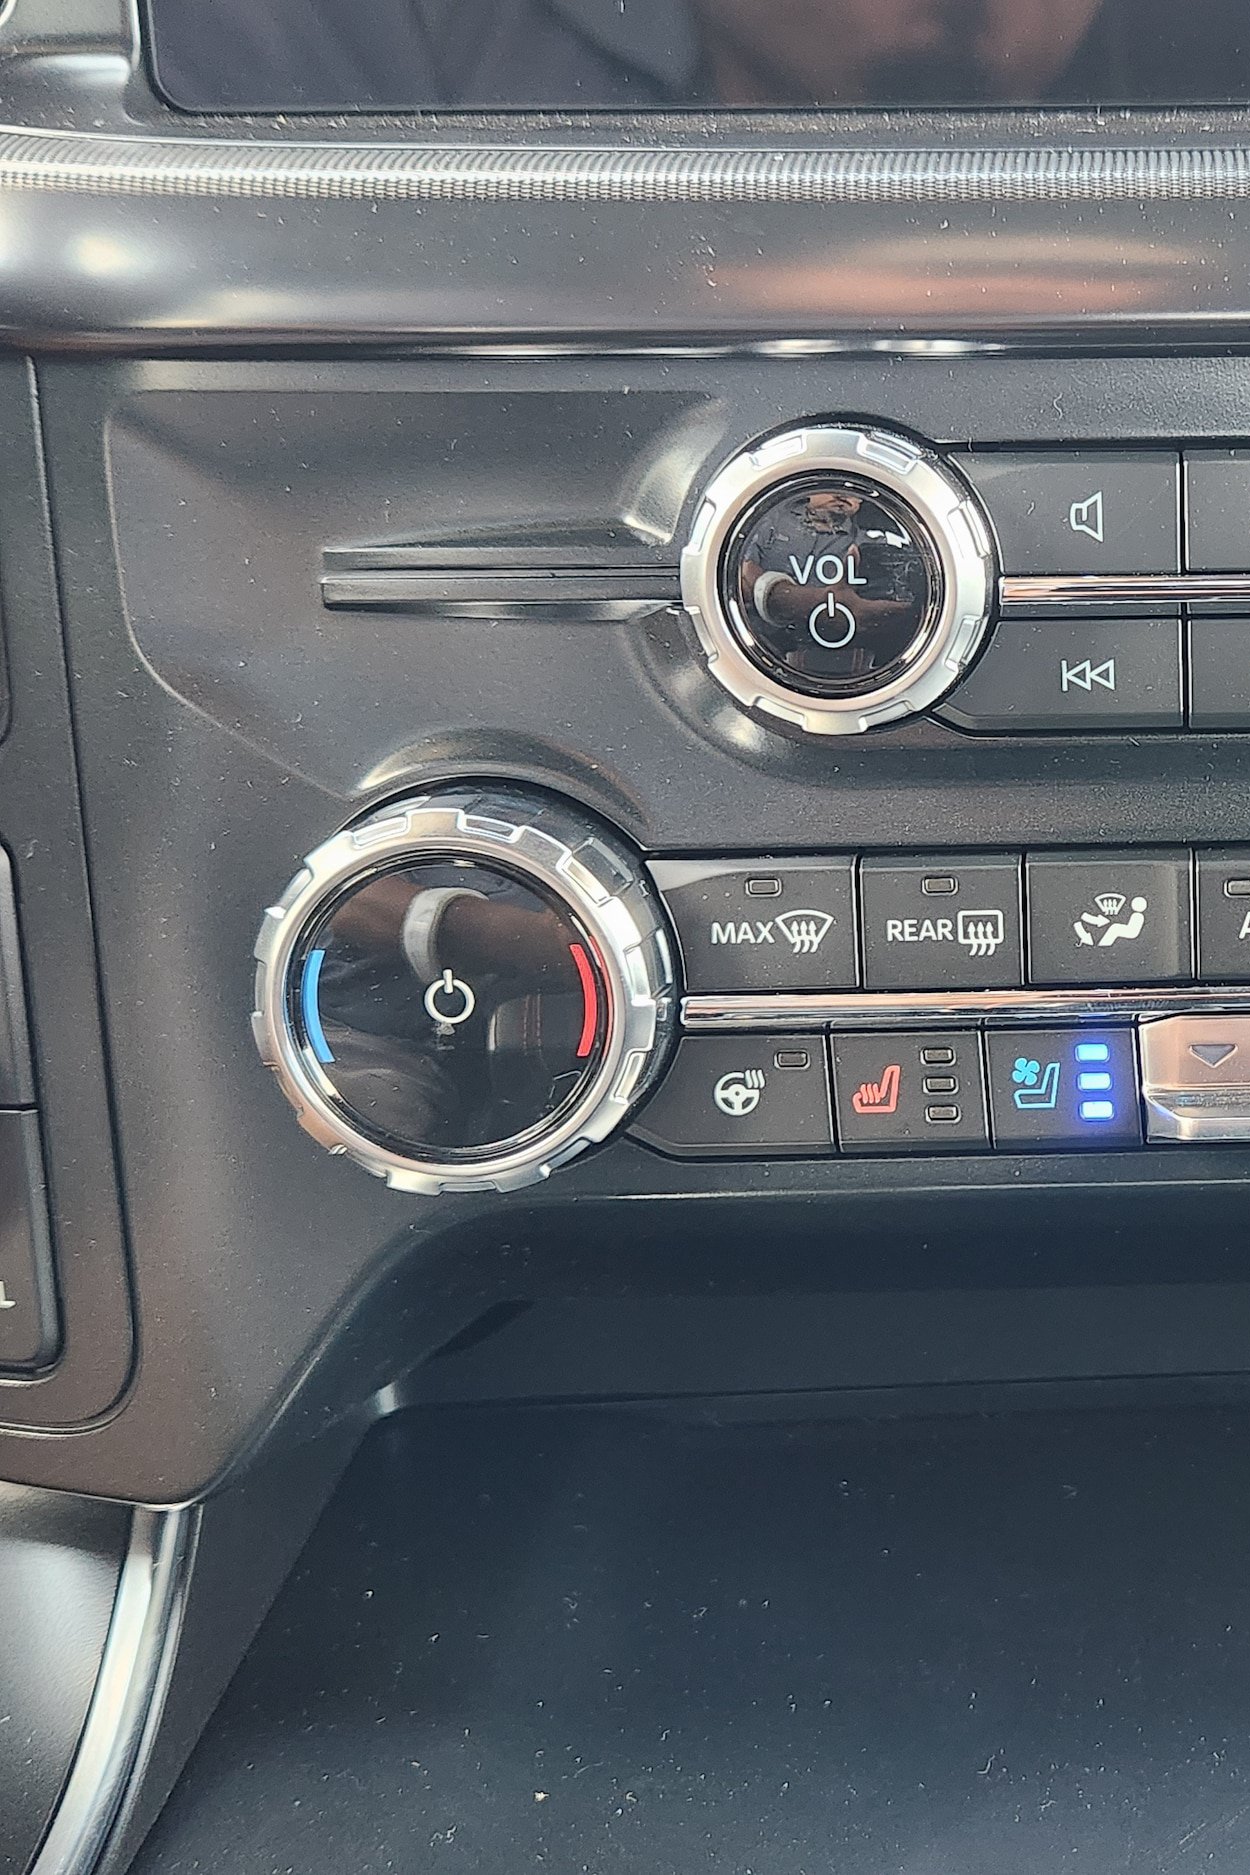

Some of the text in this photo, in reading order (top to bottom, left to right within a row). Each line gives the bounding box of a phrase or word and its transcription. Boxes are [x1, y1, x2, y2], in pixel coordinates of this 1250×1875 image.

[789, 554, 867, 585] VOL
[711, 921, 776, 944] MAX
[886, 918, 954, 943] REAR
